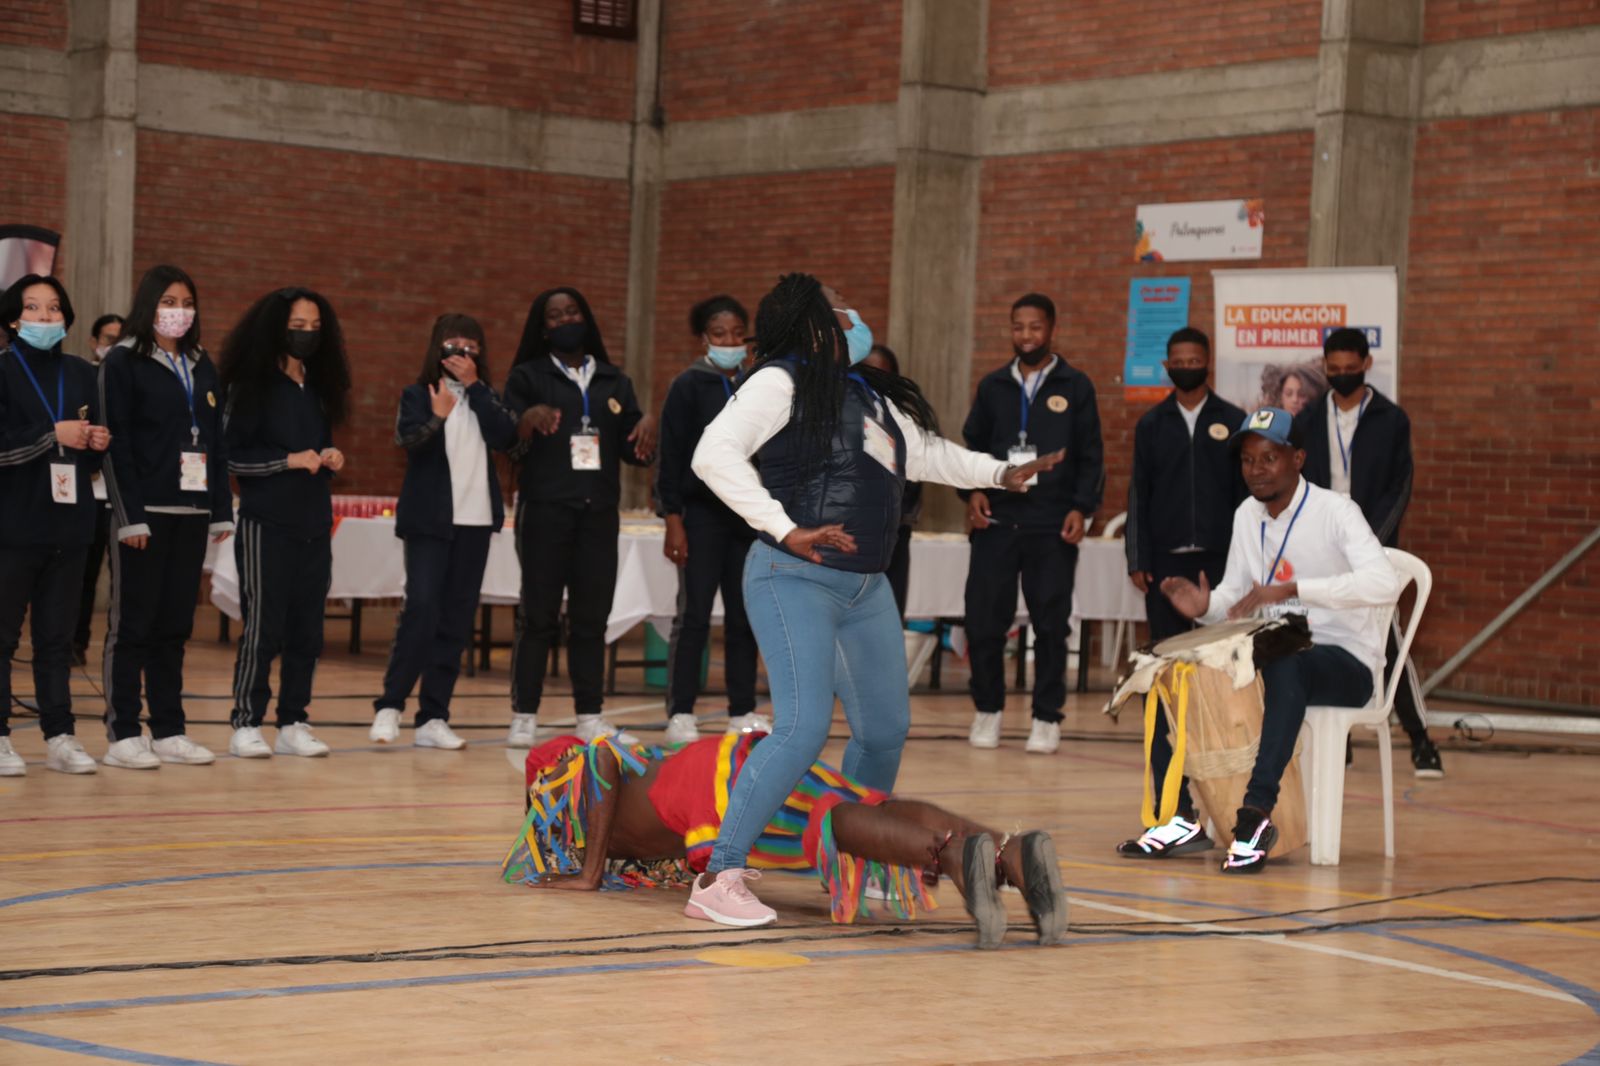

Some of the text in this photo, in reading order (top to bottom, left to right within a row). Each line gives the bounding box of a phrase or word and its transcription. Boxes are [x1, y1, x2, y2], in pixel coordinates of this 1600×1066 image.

[1226, 305, 1341, 323] LA EDUCACIÓN
[1238, 328, 1257, 345] EN
[1262, 328, 1319, 344] PRIMER
